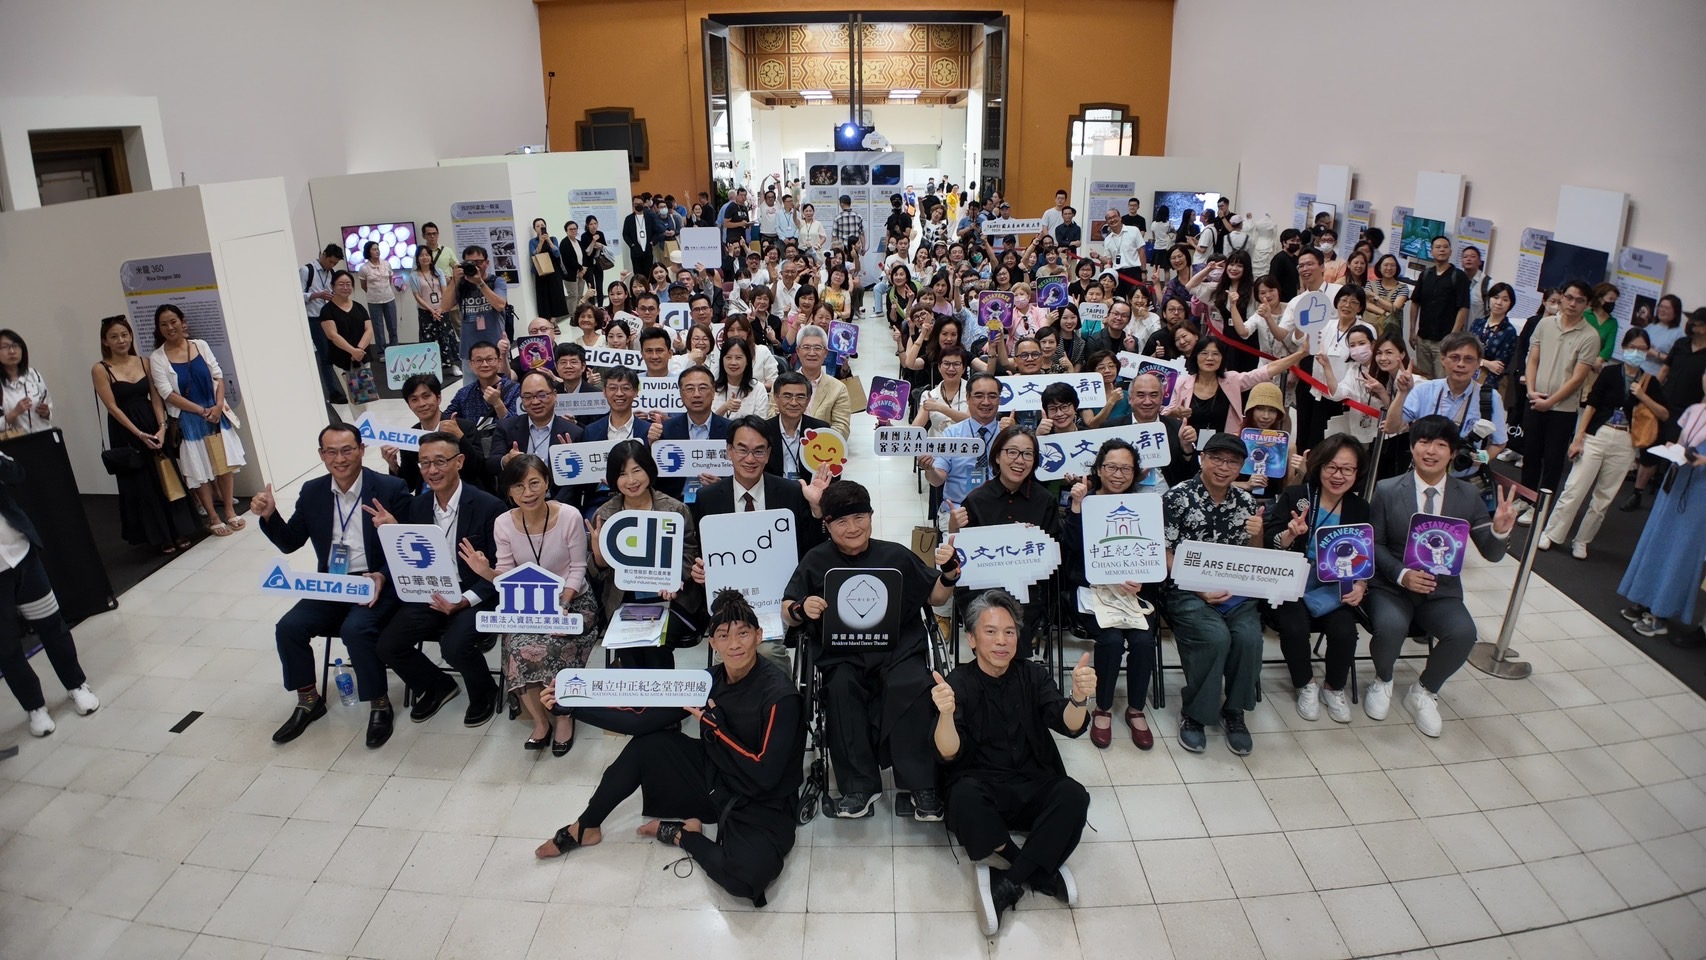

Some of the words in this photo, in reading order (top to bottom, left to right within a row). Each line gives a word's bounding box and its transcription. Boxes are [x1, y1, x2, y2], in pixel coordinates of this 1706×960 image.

[152, 264, 164, 273] 360
[982, 292, 1011, 304] METAVERSE
[520, 337, 547, 350] METAVERSE
[1018, 378, 1103, 397] 文部
[869, 400, 902, 413] METAVERSE
[379, 430, 418, 444] DELTA
[880, 431, 922, 440] 財團法人
[1244, 434, 1287, 443] METAVERSE
[1070, 430, 1164, 459] 文部
[692, 449, 730, 460] 中華電
[709, 518, 790, 567] moda
[1319, 528, 1366, 548] METAVERSE
[970, 540, 1046, 560] 文化部
[1090, 542, 1161, 558] 中正紀念堂
[1203, 560, 1224, 570] ARS
[1226, 562, 1294, 577] ELECTRONICA
[398, 575, 453, 588] 中華電信
[1214, 570, 1248, 581] Technology
[1257, 576, 1279, 584] Society
[295, 578, 342, 593] DELTA
[346, 582, 370, 596] 台達
[481, 615, 578, 625] 財團法人資訊工業策進會
[592, 680, 707, 692] 國立中正紀念堂管理處
